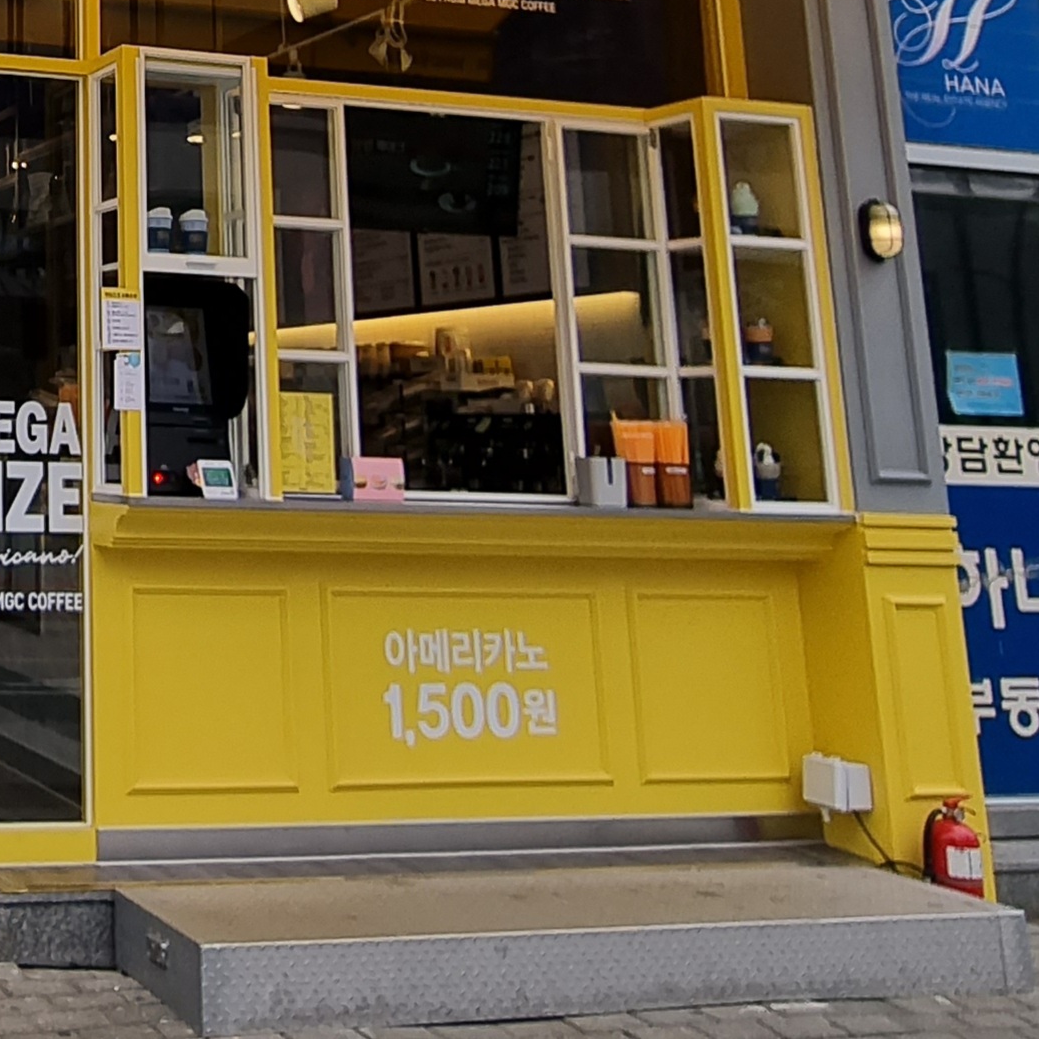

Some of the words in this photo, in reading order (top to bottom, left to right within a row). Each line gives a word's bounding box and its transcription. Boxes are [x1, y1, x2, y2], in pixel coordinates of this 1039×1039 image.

[521, 0, 557, 14] COFFEE
[944, 73, 1006, 98] HANA
[28, 591, 83, 611] COFFEE
[384, 628, 549, 675] 아메리카노
